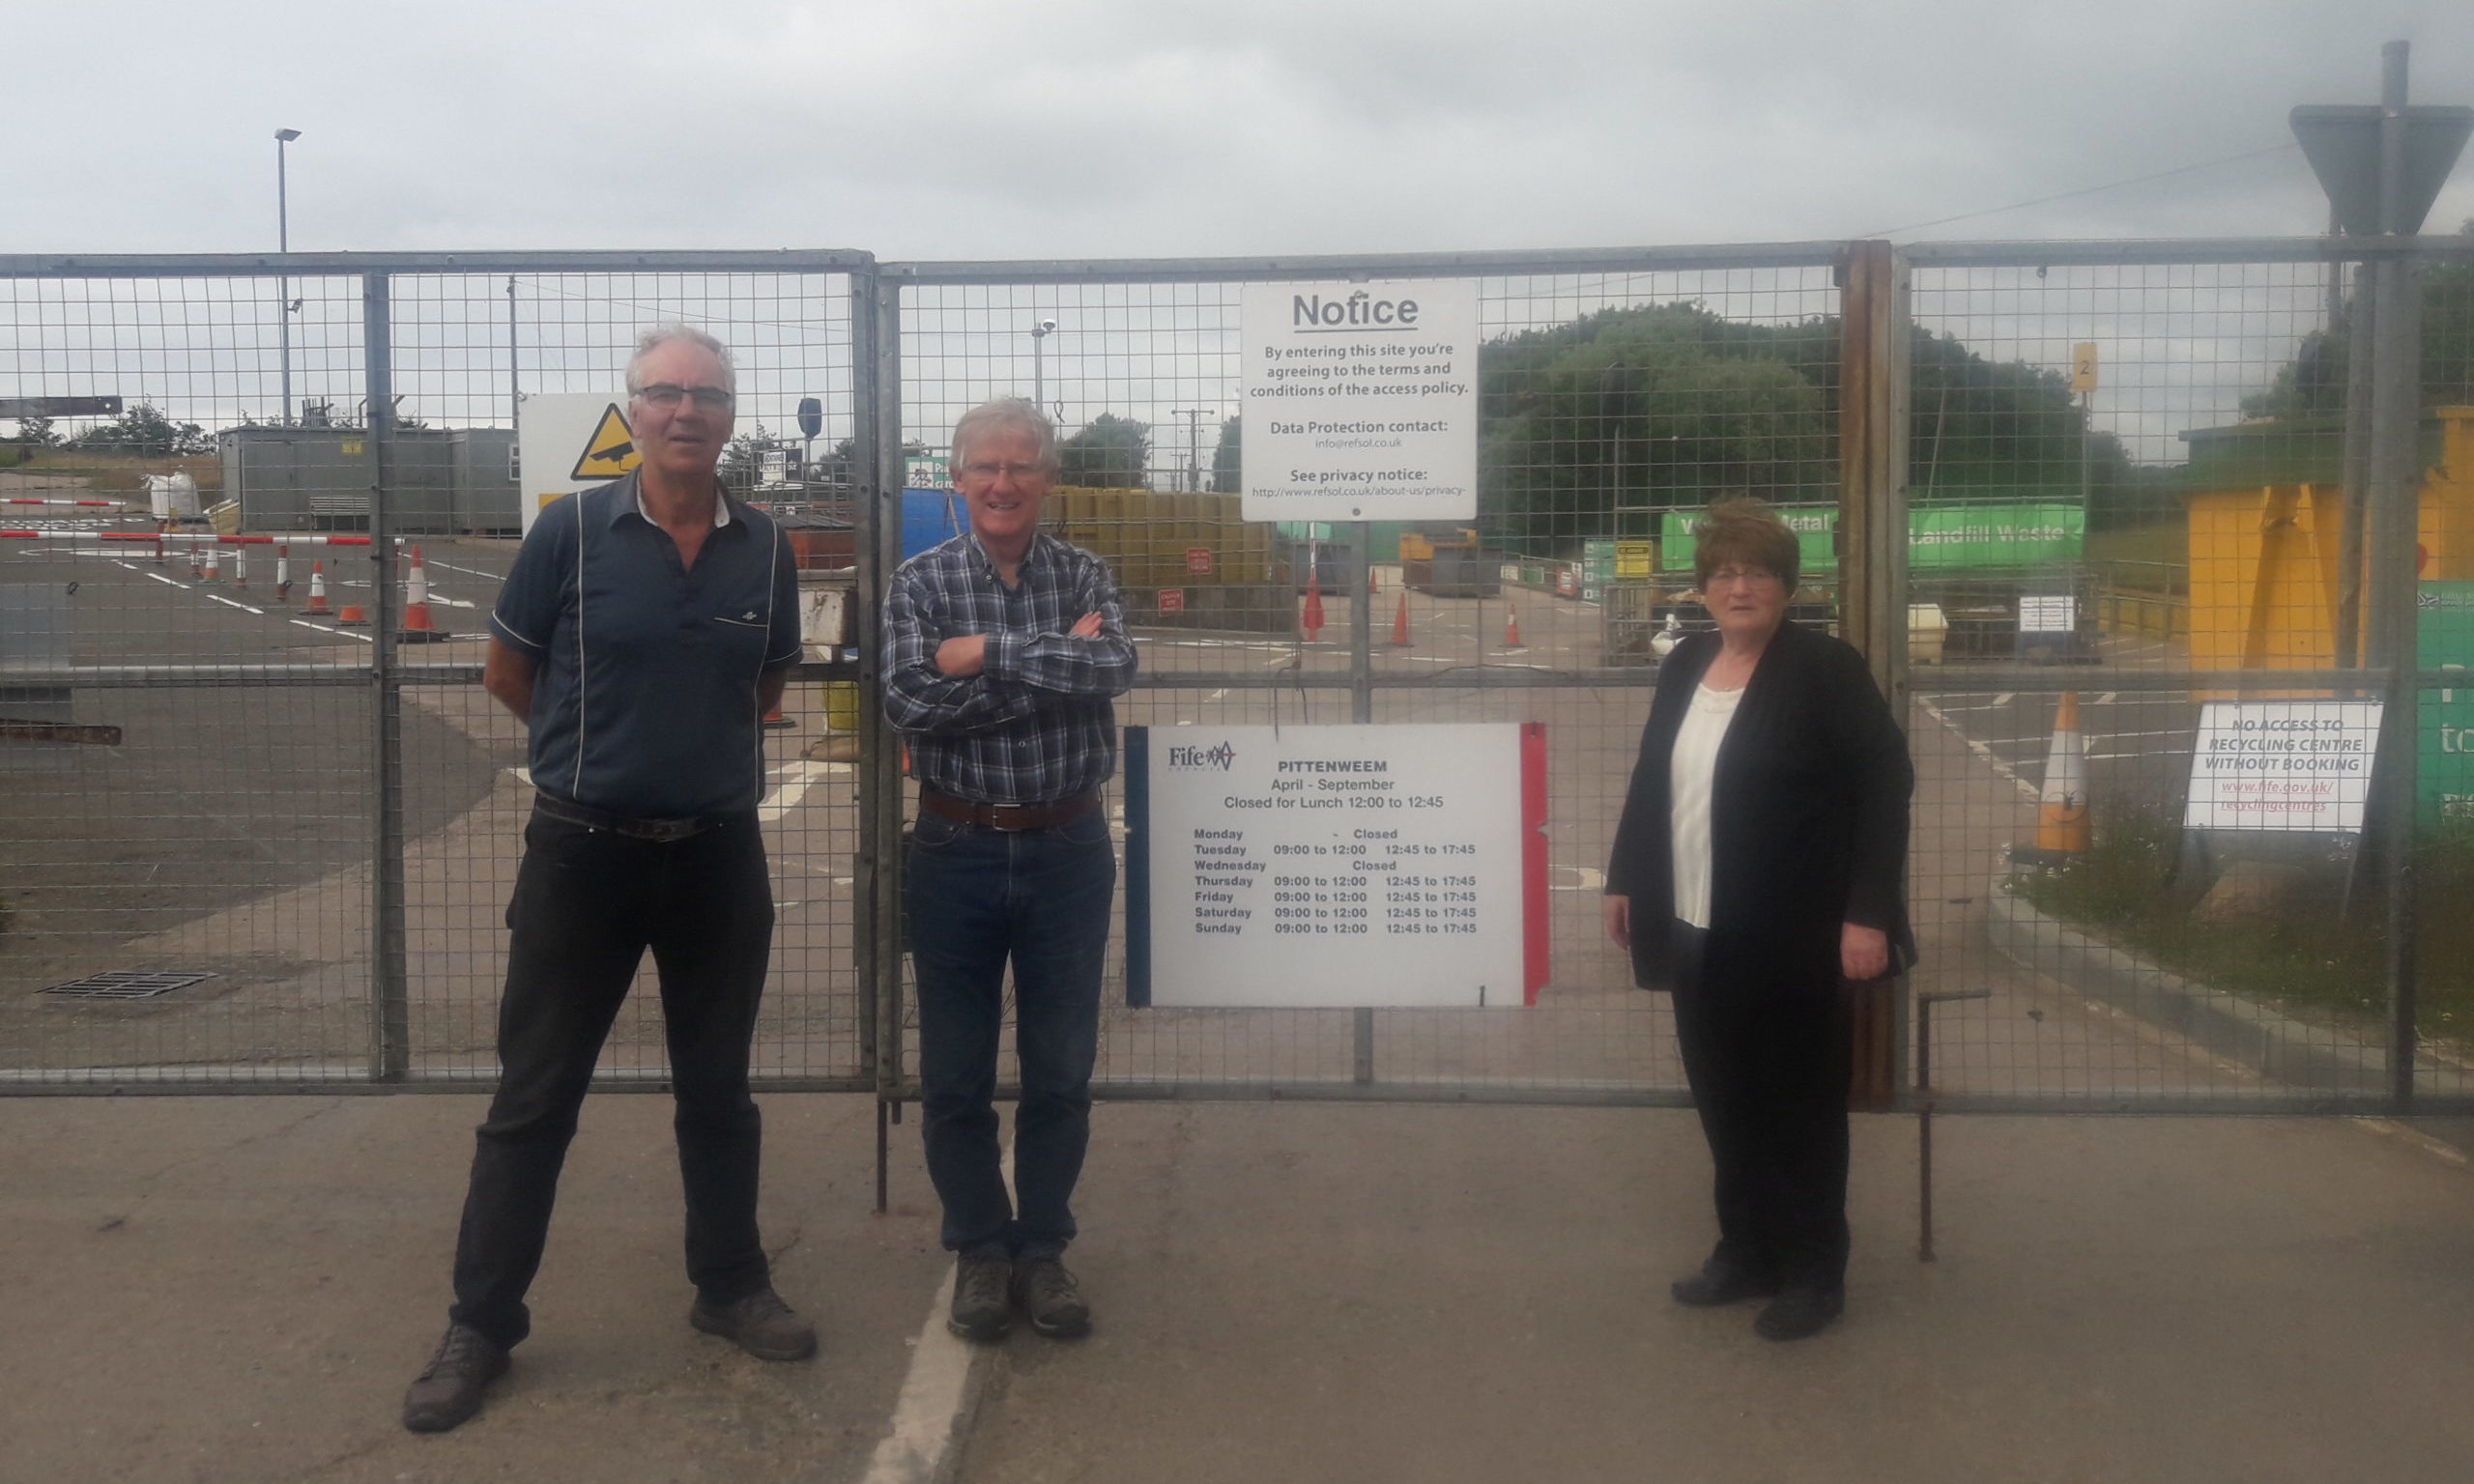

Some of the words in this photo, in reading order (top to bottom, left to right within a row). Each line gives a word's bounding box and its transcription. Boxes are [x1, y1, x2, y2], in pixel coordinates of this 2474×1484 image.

[1293, 295, 1419, 326] Notice
[1265, 347, 1282, 360] By
[1286, 345, 1345, 359] entering
[1350, 344, 1376, 356] this
[1380, 344, 1405, 356] site
[1409, 343, 1453, 357] you're
[1267, 365, 1330, 380] agreeing
[1334, 365, 1348, 376] to
[1353, 364, 1375, 375] the
[1380, 364, 1420, 375] terms
[1424, 362, 1451, 374] and
[2080, 360, 2089, 375] 2
[1251, 385, 1324, 397] conditions
[1328, 384, 1342, 395] of
[1346, 384, 1369, 395] the
[1373, 385, 1418, 395] access
[1422, 381, 1468, 396] policy.
[1271, 422, 1304, 434] Data
[1309, 421, 1384, 433] Protection
[1389, 420, 1448, 432] contact:
[1315, 438, 1401, 449] info@refsol.co.uk
[1291, 470, 1316, 481] See
[1320, 469, 1373, 483] privacy
[1377, 469, 1427, 480] notice:
[1910, 526, 1990, 545] Landfill
[1998, 525, 2064, 542] Waste
[2232, 720, 2256, 731] NO
[2258, 720, 2318, 731] ACCESS
[2322, 720, 2344, 731] TO
[2210, 739, 2295, 751] RECYCLING
[2299, 739, 2363, 751] CENTRE
[1169, 746, 1204, 766] Fife
[1279, 761, 1387, 772] PITTENWEEM
[2205, 757, 2280, 770] WITHOUT
[2283, 758, 2359, 771] BOOKING
[1271, 779, 1303, 792] April
[1318, 778, 1395, 792] September
[1224, 796, 1272, 809] Closed
[1277, 796, 1295, 809] for
[1300, 796, 1342, 809] Lunch
[1348, 796, 1384, 809] 12:00
[1389, 797, 1402, 809] to
[1408, 796, 1444, 808] 12:45
[1194, 829, 1243, 841] Monday
[1353, 829, 1397, 839] Closed
[1194, 844, 1247, 856] Tuesday
[1274, 845, 1309, 855] 09:00
[1314, 845, 1327, 855] to
[1333, 845, 1366, 855] 12:00
[1385, 845, 1420, 855] 12:45
[1424, 845, 1437, 855] to
[1442, 845, 1476, 855] 17:45
[1194, 861, 1266, 872] Wednesday
[1353, 861, 1396, 870] Closed
[1194, 876, 1252, 888] Thursday
[1275, 876, 1310, 887] 09:00
[1315, 876, 1328, 887] to
[1333, 876, 1366, 887] 12:00
[1386, 876, 1421, 887] 12:45
[1424, 876, 1437, 887] to
[1443, 876, 1476, 887] 17:45
[1194, 892, 1233, 903] Friday
[1275, 892, 1310, 902] 09:00
[1315, 892, 1328, 902] to
[1333, 892, 1366, 902] 12:00
[1386, 892, 1421, 902] 12:45
[1424, 892, 1437, 902] to
[1443, 892, 1476, 902] 17:45
[1194, 907, 1251, 920] Saturday
[1275, 908, 1310, 918] 09:00
[1315, 908, 1328, 918] to
[1333, 908, 1366, 918] 12:00
[1386, 908, 1421, 918] 12:45
[1424, 908, 1437, 918] to
[1443, 908, 1476, 918] 17:45
[1194, 923, 1242, 935] Sunday
[1275, 924, 1310, 933] 09:00
[1315, 924, 1328, 933] to
[1333, 924, 1366, 933] 12:00
[1386, 924, 1421, 933] 12:45
[1424, 924, 1437, 933] to
[1443, 924, 1476, 933] 17:45
